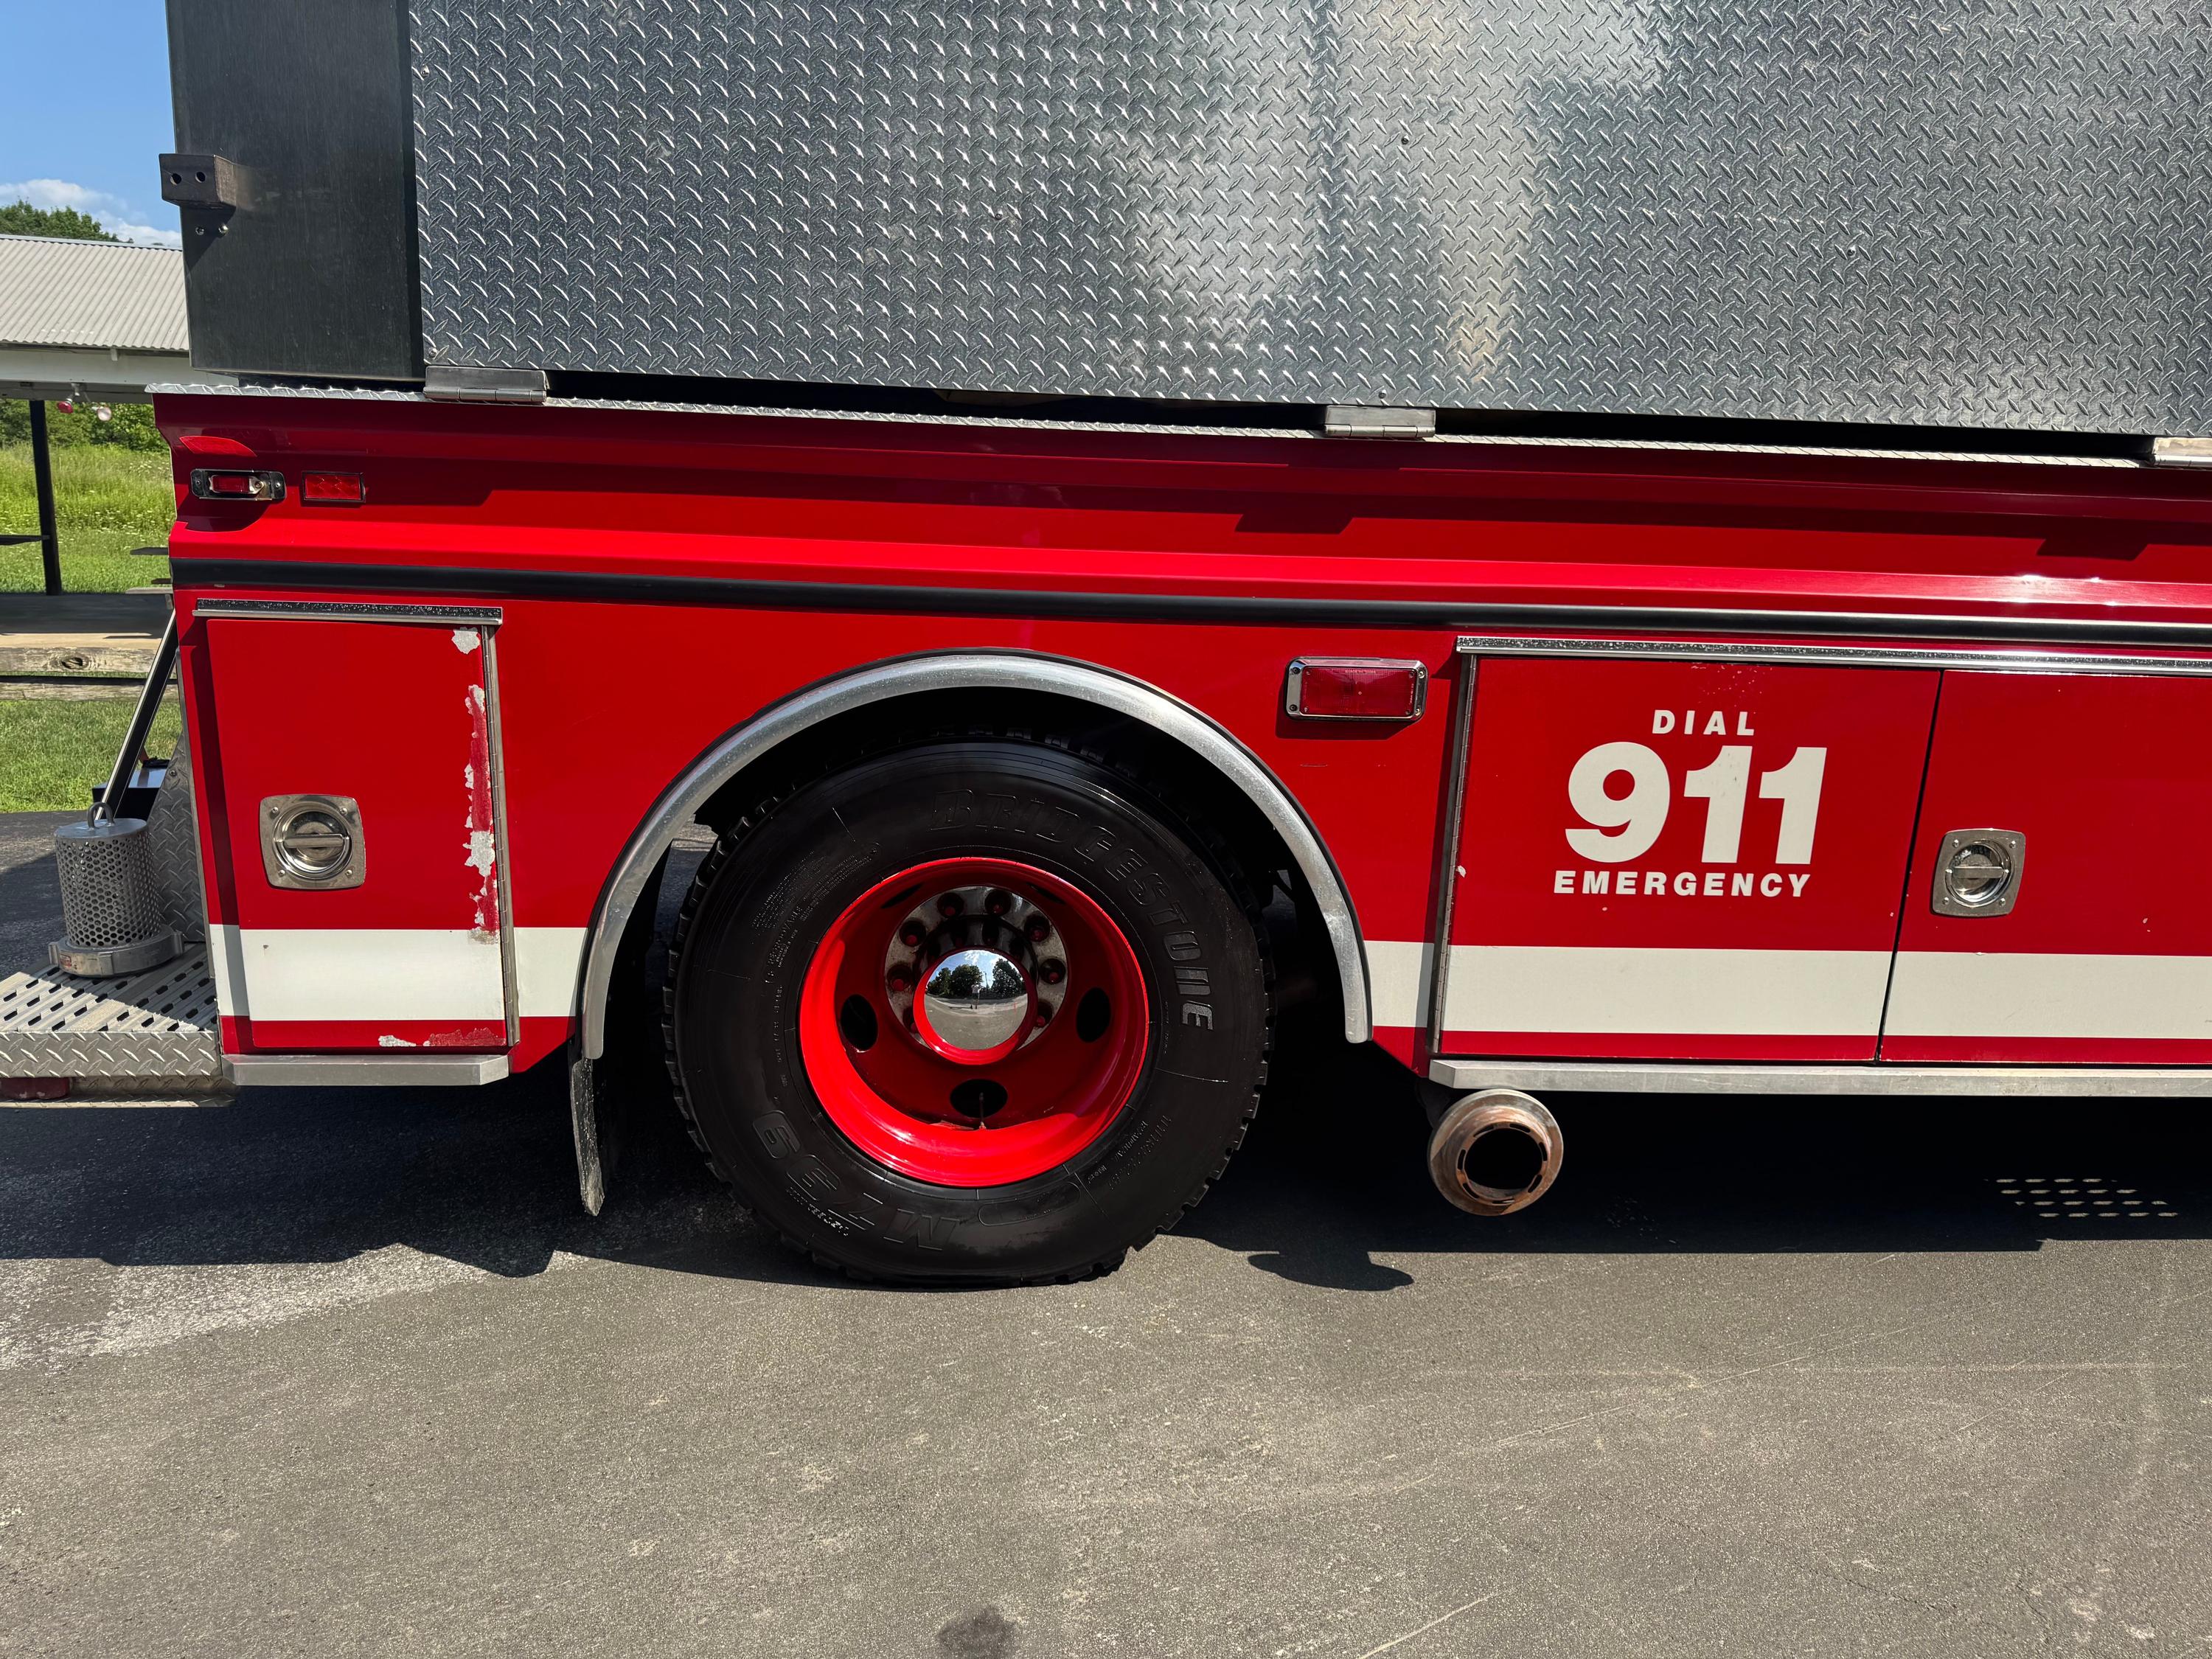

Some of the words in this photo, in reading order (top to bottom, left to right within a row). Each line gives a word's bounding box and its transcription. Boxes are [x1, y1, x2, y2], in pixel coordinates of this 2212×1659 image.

[1652, 709, 1755, 736] DIAL
[1565, 742, 1827, 865] 911
[930, 789, 1214, 1031] BRIDGESTONE
[1554, 870, 1811, 897] EMERGENCY
